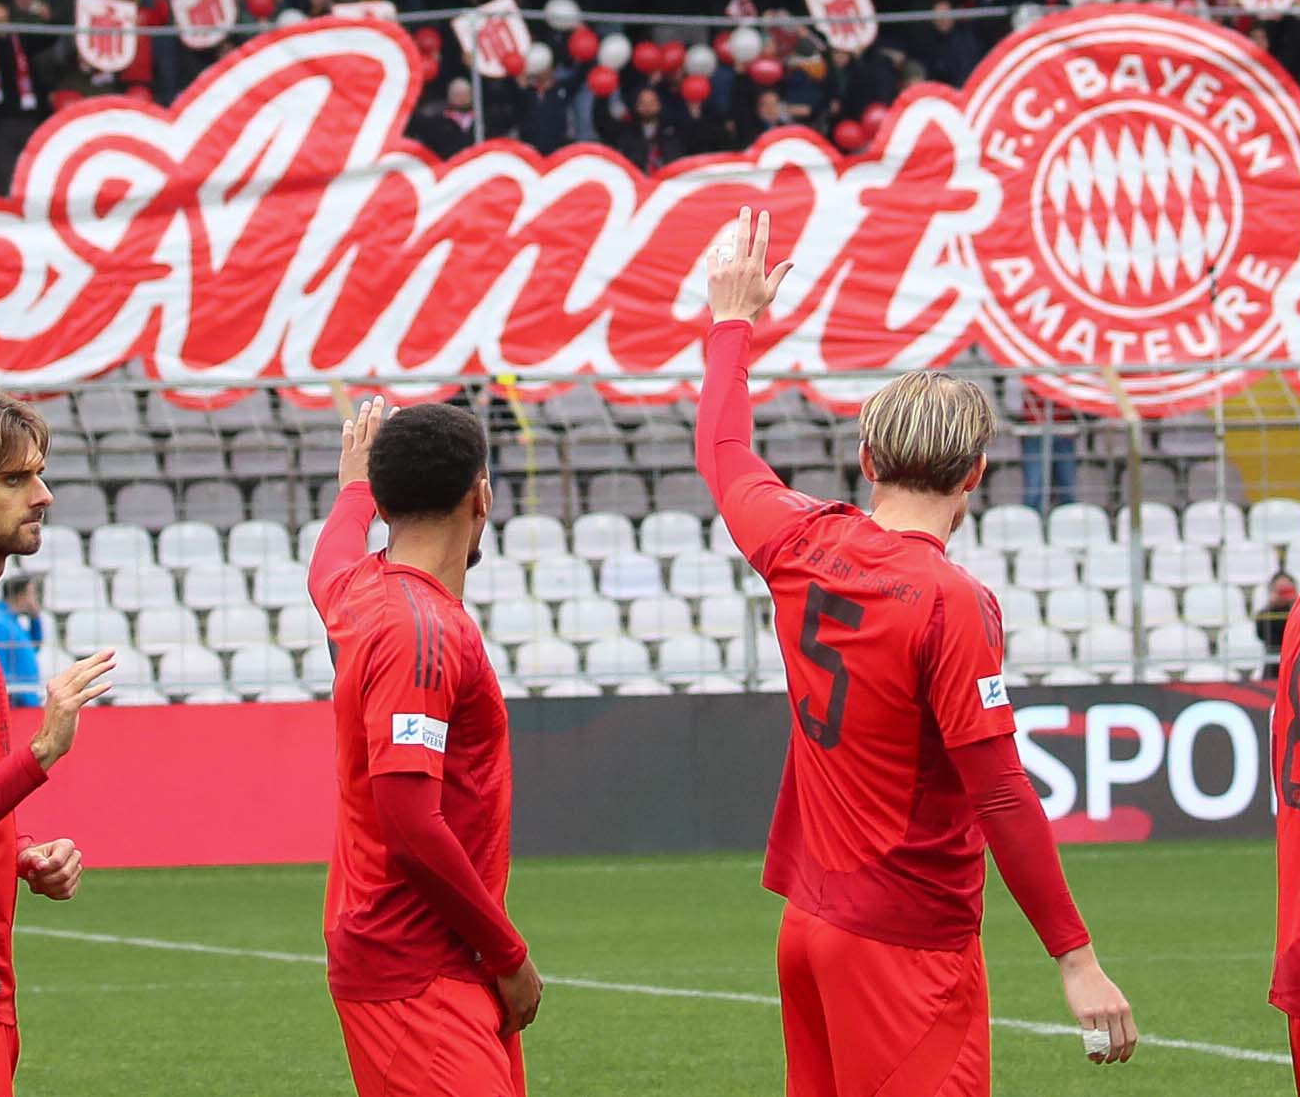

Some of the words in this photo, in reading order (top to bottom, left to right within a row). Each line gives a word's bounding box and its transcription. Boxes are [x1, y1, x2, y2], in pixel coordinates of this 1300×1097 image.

[986, 87, 1068, 170] F.C.
[1063, 53, 1285, 178] BAYERN
[990, 252, 1281, 367] AMATEURE
[798, 581, 865, 750] 5
